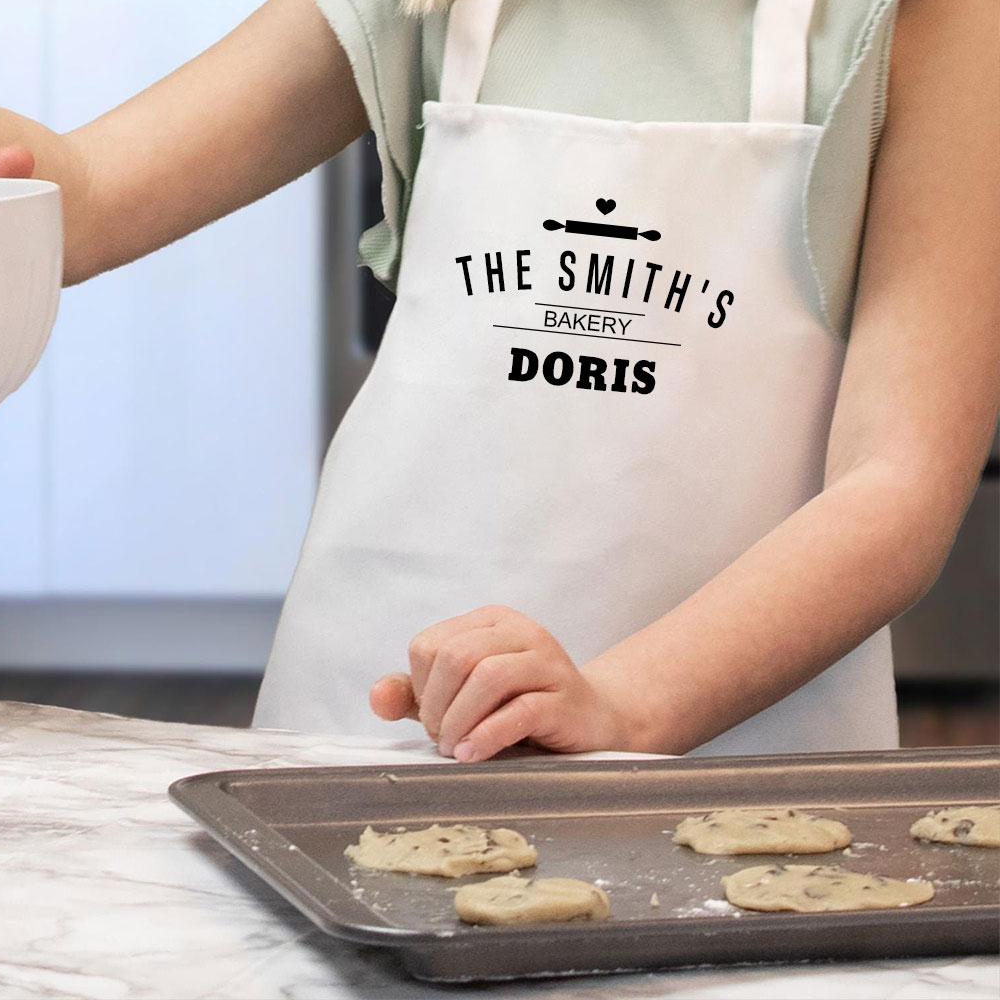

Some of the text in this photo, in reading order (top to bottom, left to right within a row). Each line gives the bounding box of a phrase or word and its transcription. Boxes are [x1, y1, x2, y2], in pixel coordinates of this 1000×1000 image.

[455, 249, 735, 329] THE SMITH'S
[544, 310, 633, 336] BAKERY
[507, 347, 656, 395] DORIS
